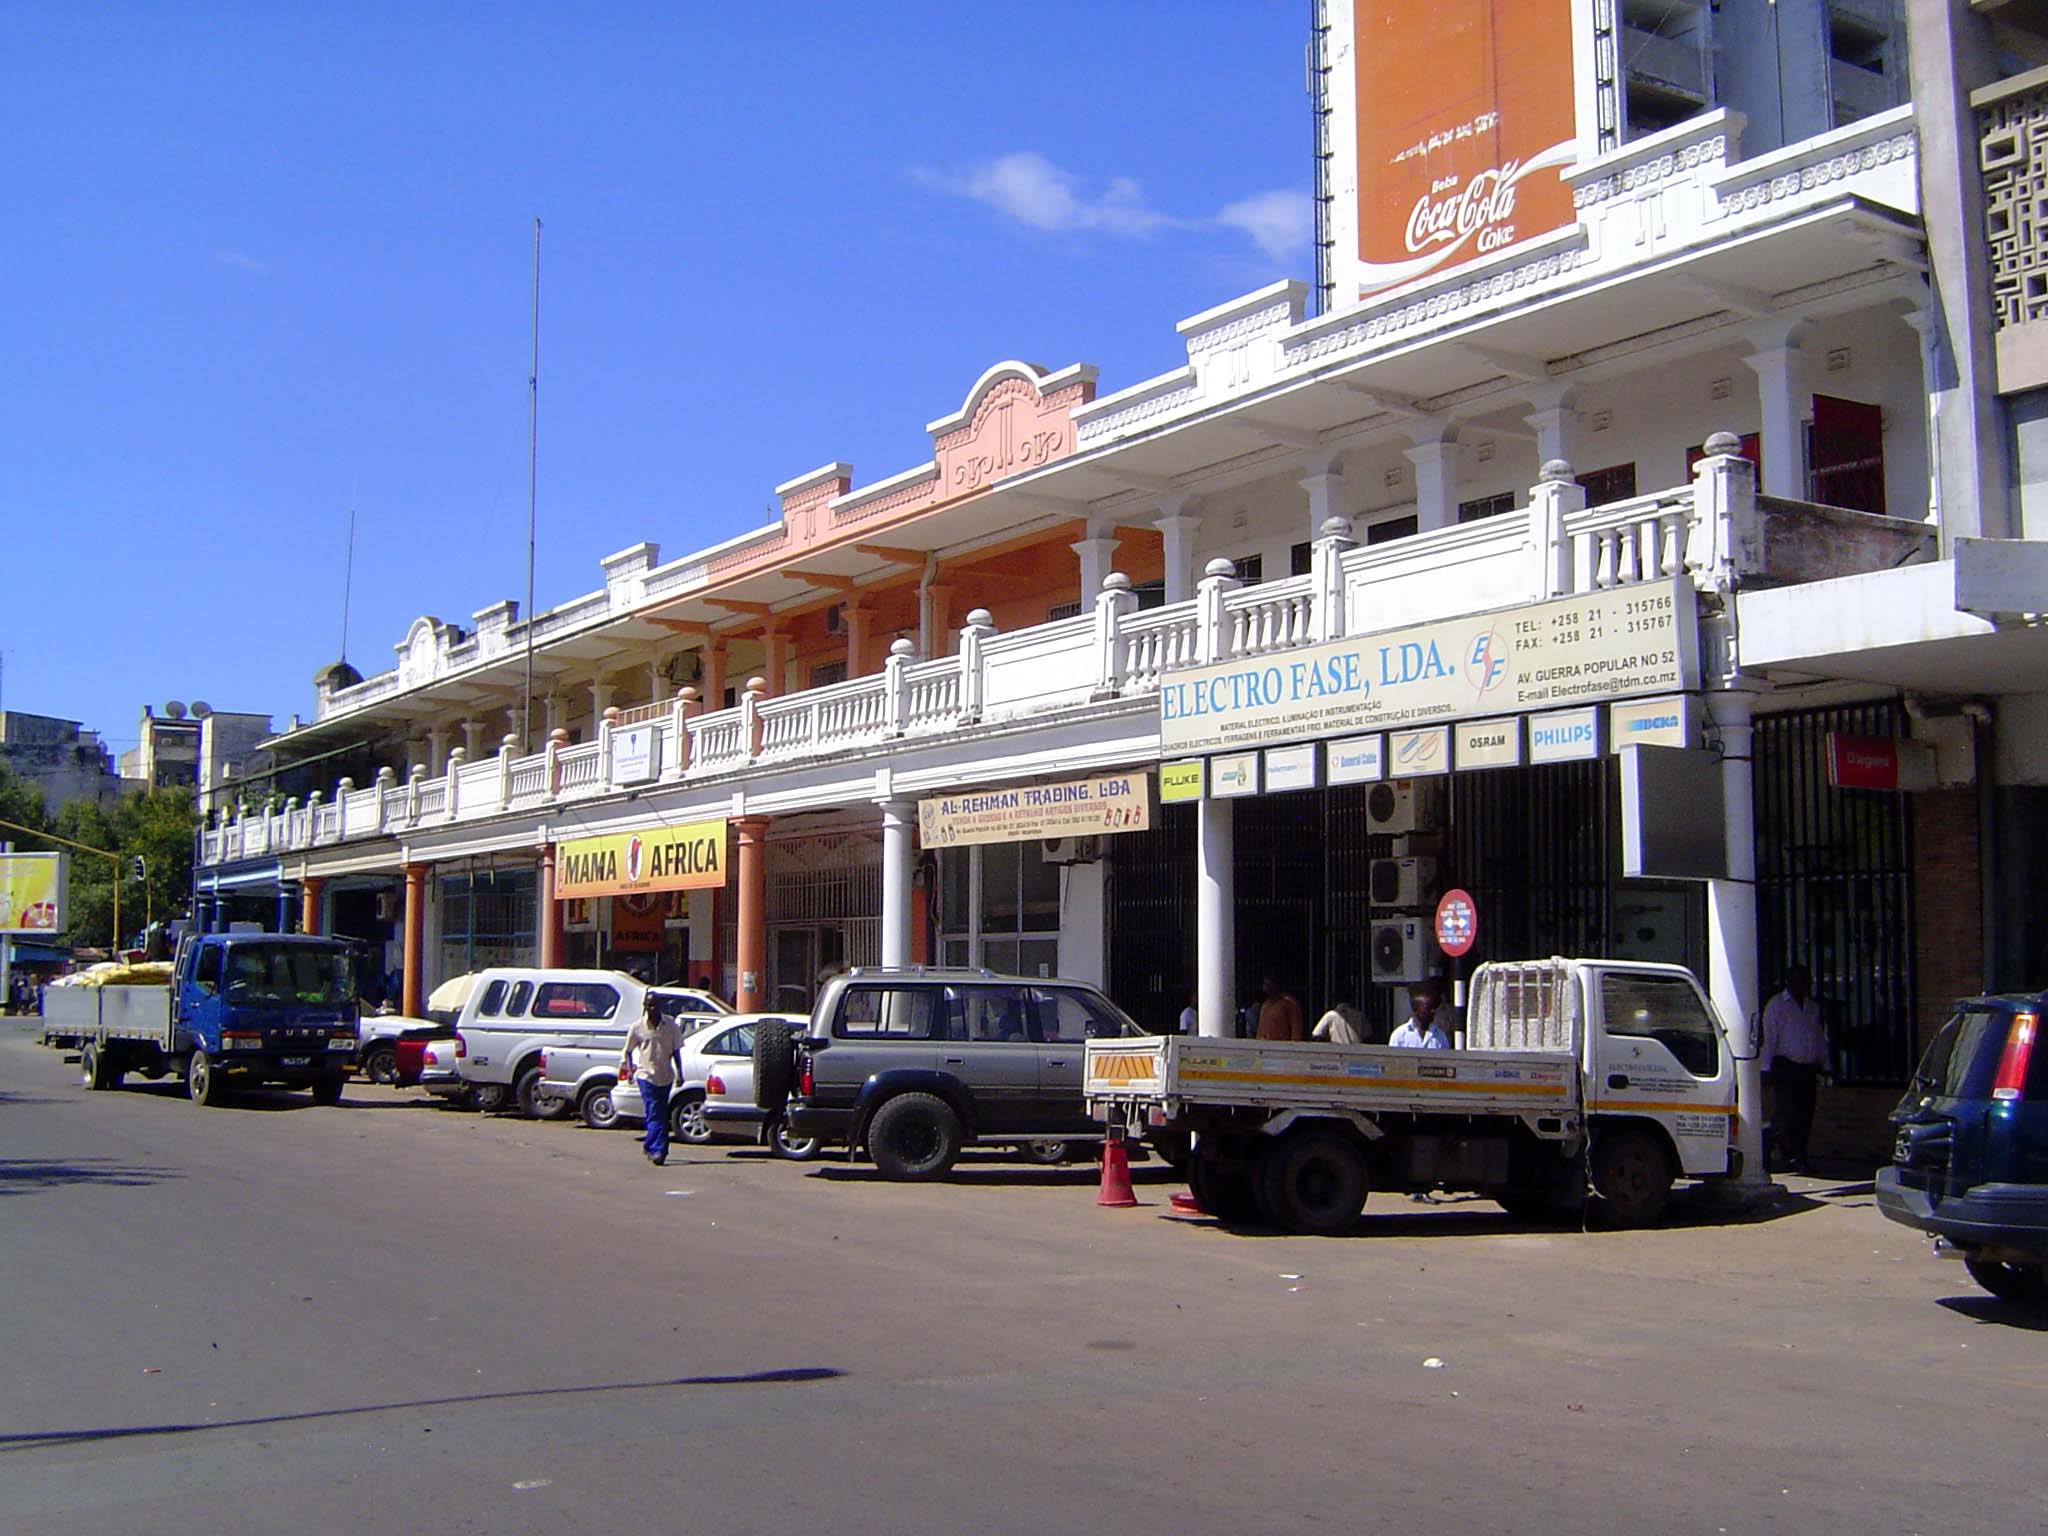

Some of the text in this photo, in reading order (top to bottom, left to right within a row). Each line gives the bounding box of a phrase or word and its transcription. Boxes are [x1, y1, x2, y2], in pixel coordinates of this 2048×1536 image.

[1432, 174, 1458, 194] Beba
[1404, 157, 1519, 253] Coca-Cola
[1477, 224, 1514, 252] Coke
[1515, 620, 1542, 634] TEL:
[1552, 612, 1579, 627] +258
[1588, 608, 1601, 621] 21
[1626, 596, 1672, 615] 315766
[1515, 636, 1543, 652] FAX:
[1553, 630, 1580, 644] +258
[1589, 626, 1603, 640] 21
[1627, 614, 1672, 633] 315767
[1162, 639, 1456, 720] ELECTRO FASE, LDA.
[1517, 651, 1675, 685] AV. GUERRA POPULAR NO 52
[1517, 671, 1676, 702] E-mail Electrofase@tdm.co.mz
[1220, 721, 1247, 732] MATERIAL
[1323, 716, 1354, 730] MATERIAL
[1354, 715, 1364, 725] DE
[1364, 708, 1410, 724] CONSTRUÇÃO
[1469, 735, 1506, 749] OSRAM
[1533, 723, 1593, 747] PHILIPS
[1099, 779, 1131, 798] LDA
[1163, 773, 1199, 787] FLUKE
[564, 850, 618, 885] MAMA
[650, 838, 719, 878] AFRICA
